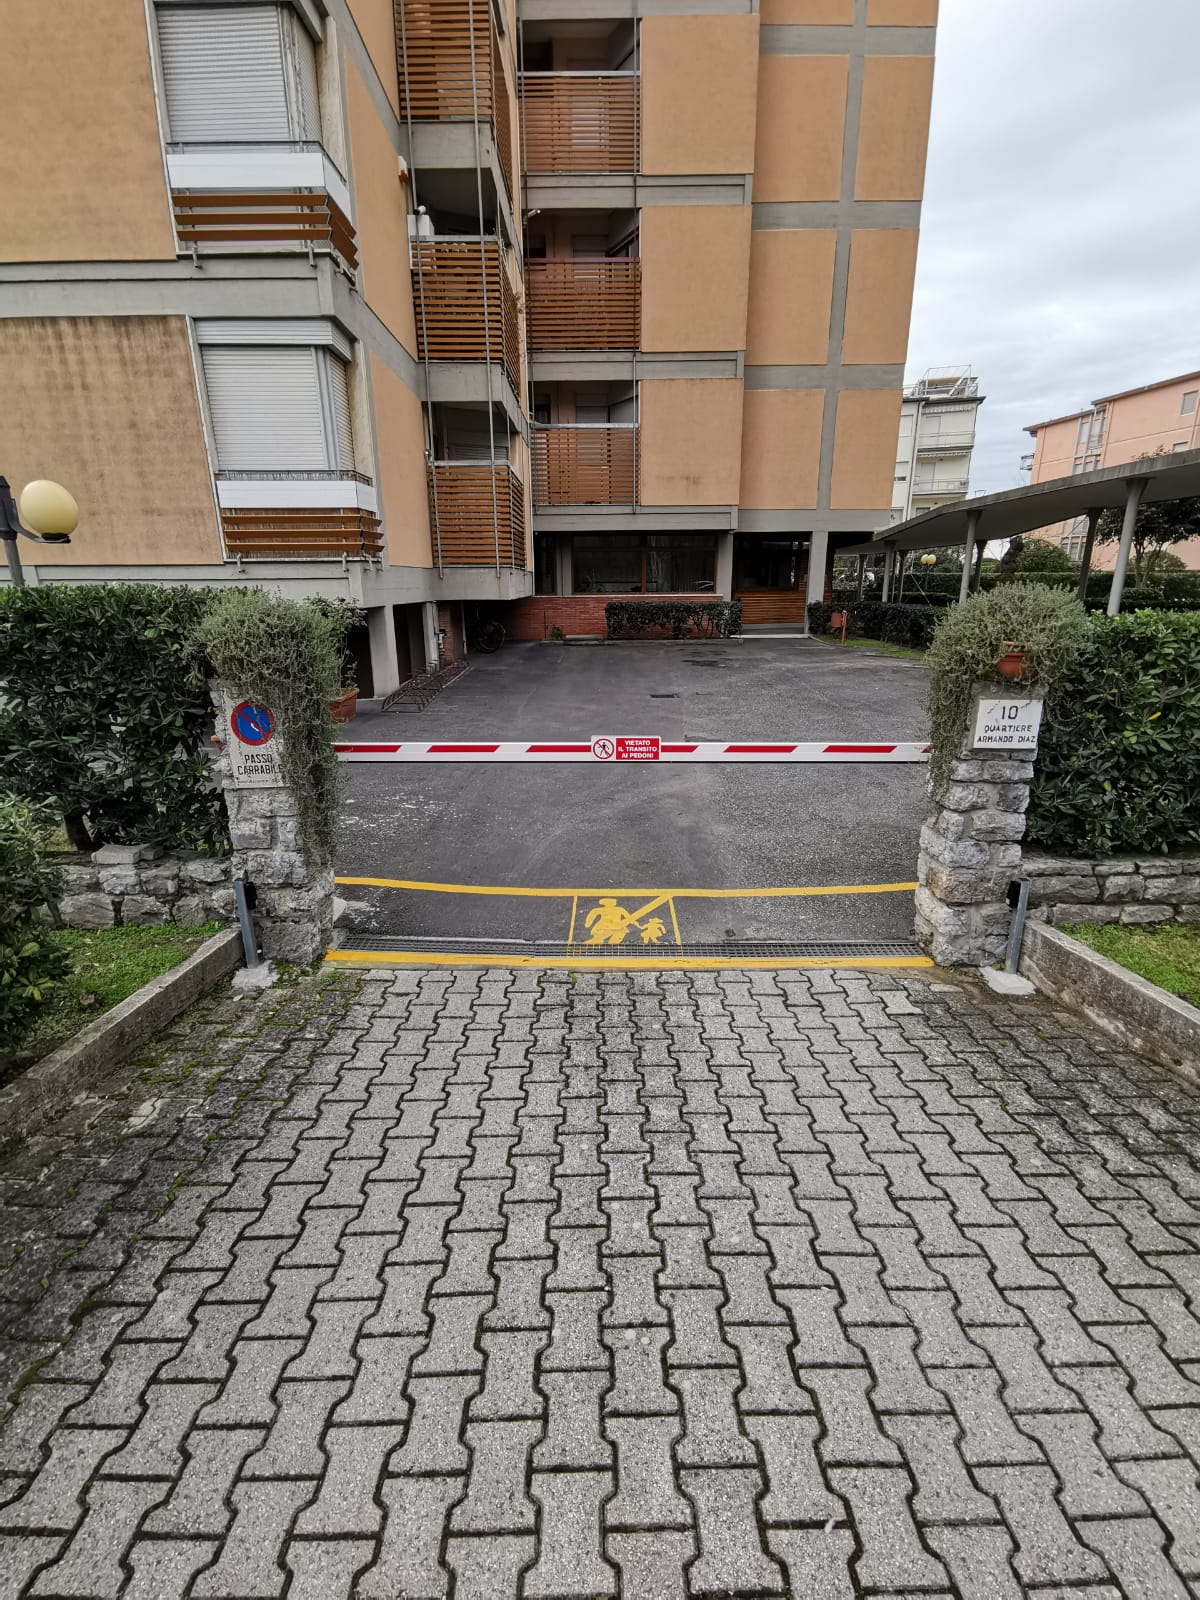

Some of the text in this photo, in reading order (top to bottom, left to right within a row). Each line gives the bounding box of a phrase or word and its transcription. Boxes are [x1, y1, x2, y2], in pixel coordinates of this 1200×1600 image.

[1001, 705, 1019, 720] 10
[984, 724, 1033, 733] QUARTIERE
[977, 735, 1036, 743] ARMANDO DIAZ
[244, 753, 273, 764] PASSO
